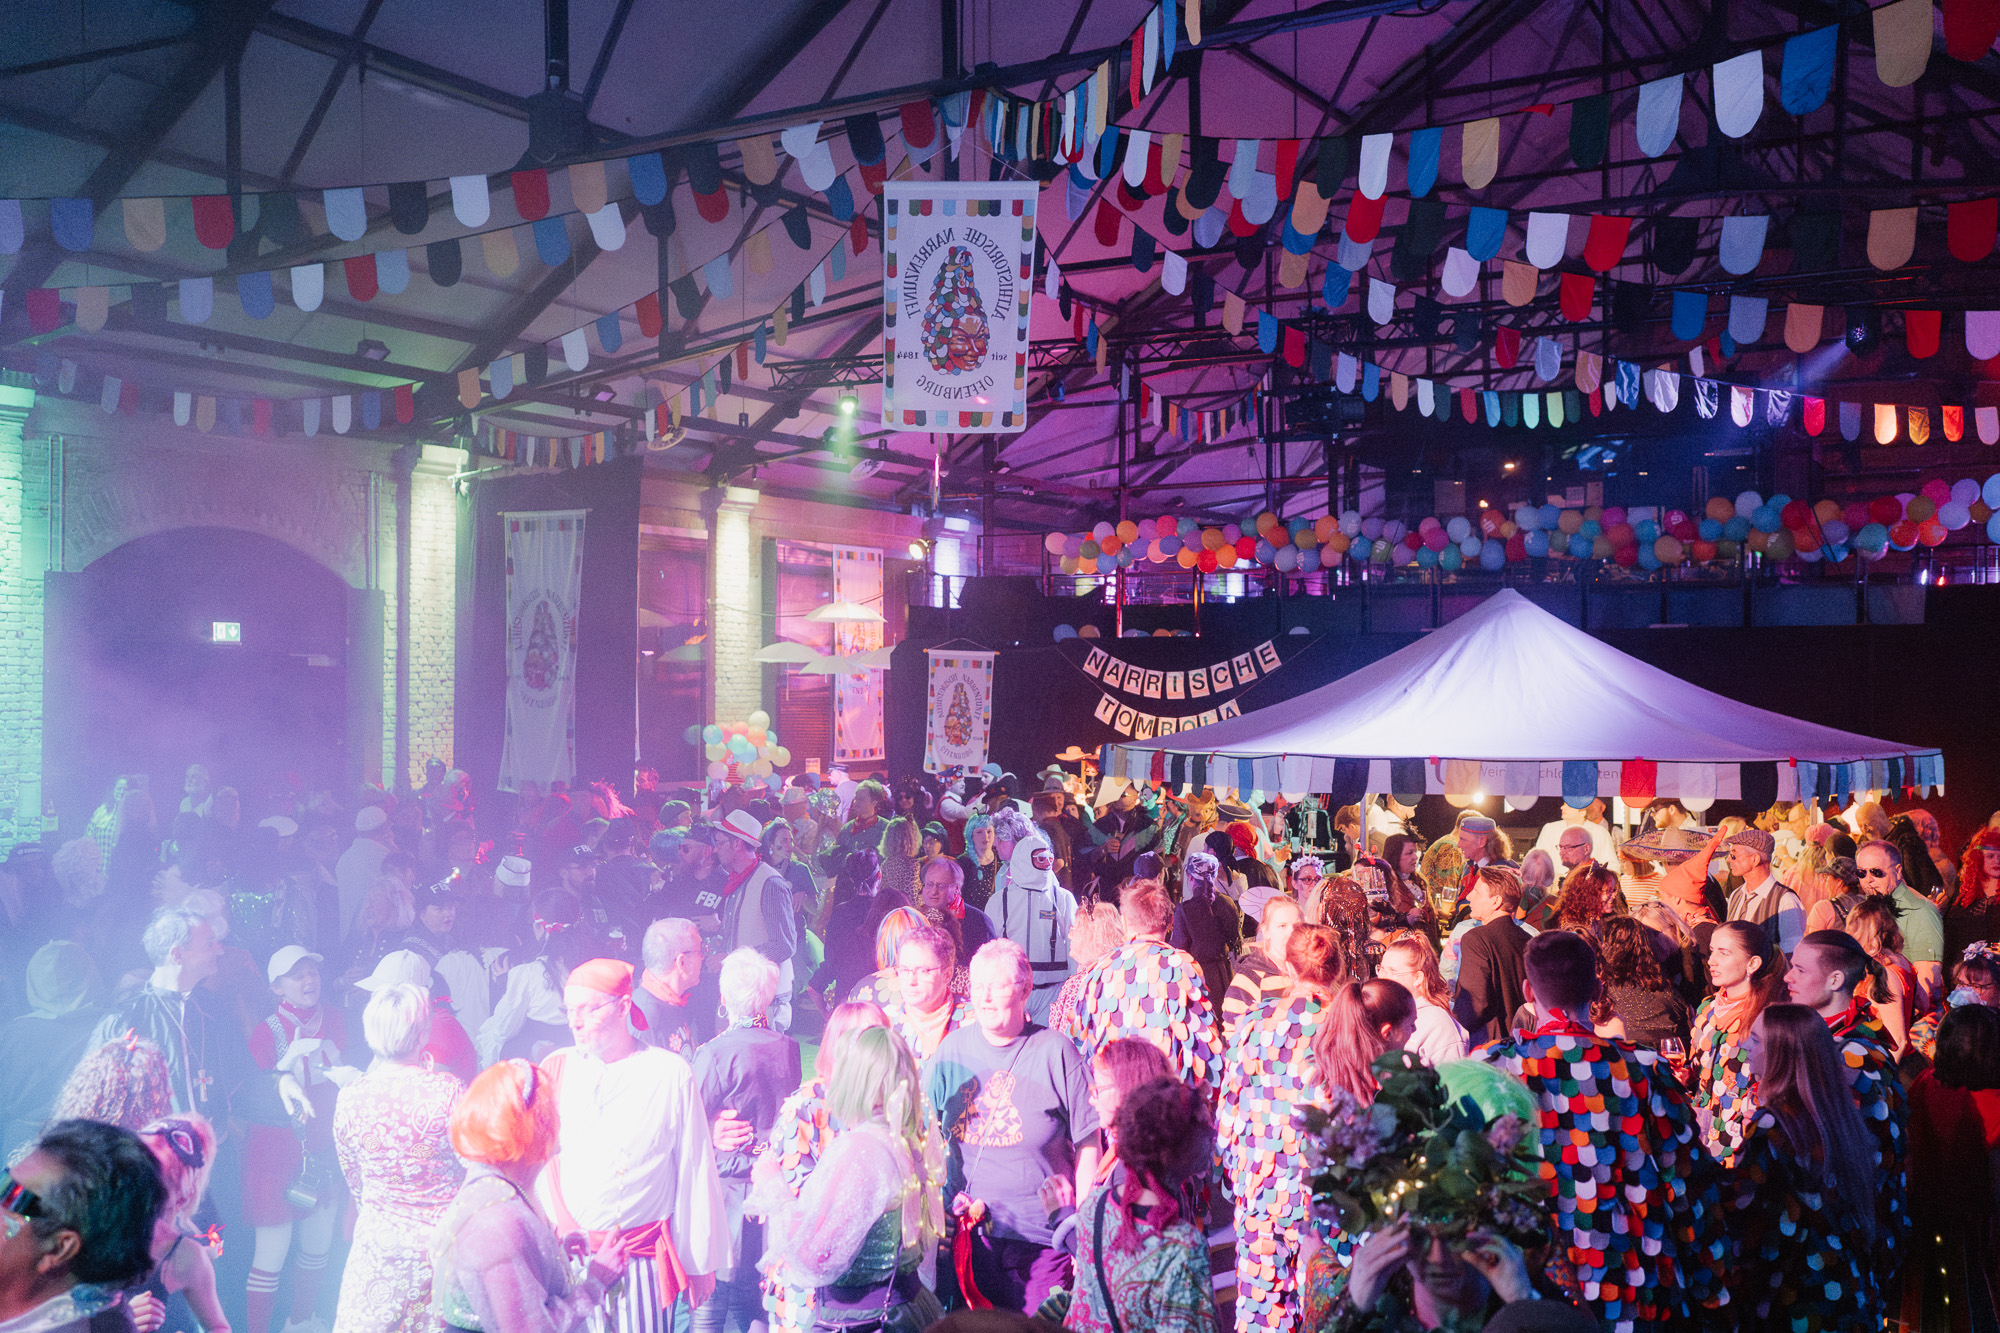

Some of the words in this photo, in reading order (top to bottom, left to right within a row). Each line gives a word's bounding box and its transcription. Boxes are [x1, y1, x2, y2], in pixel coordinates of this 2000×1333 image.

[1088, 644, 1276, 693] NÄRRISCHE
[573, 844, 593, 855] FBI
[694, 890, 723, 909] FBI
